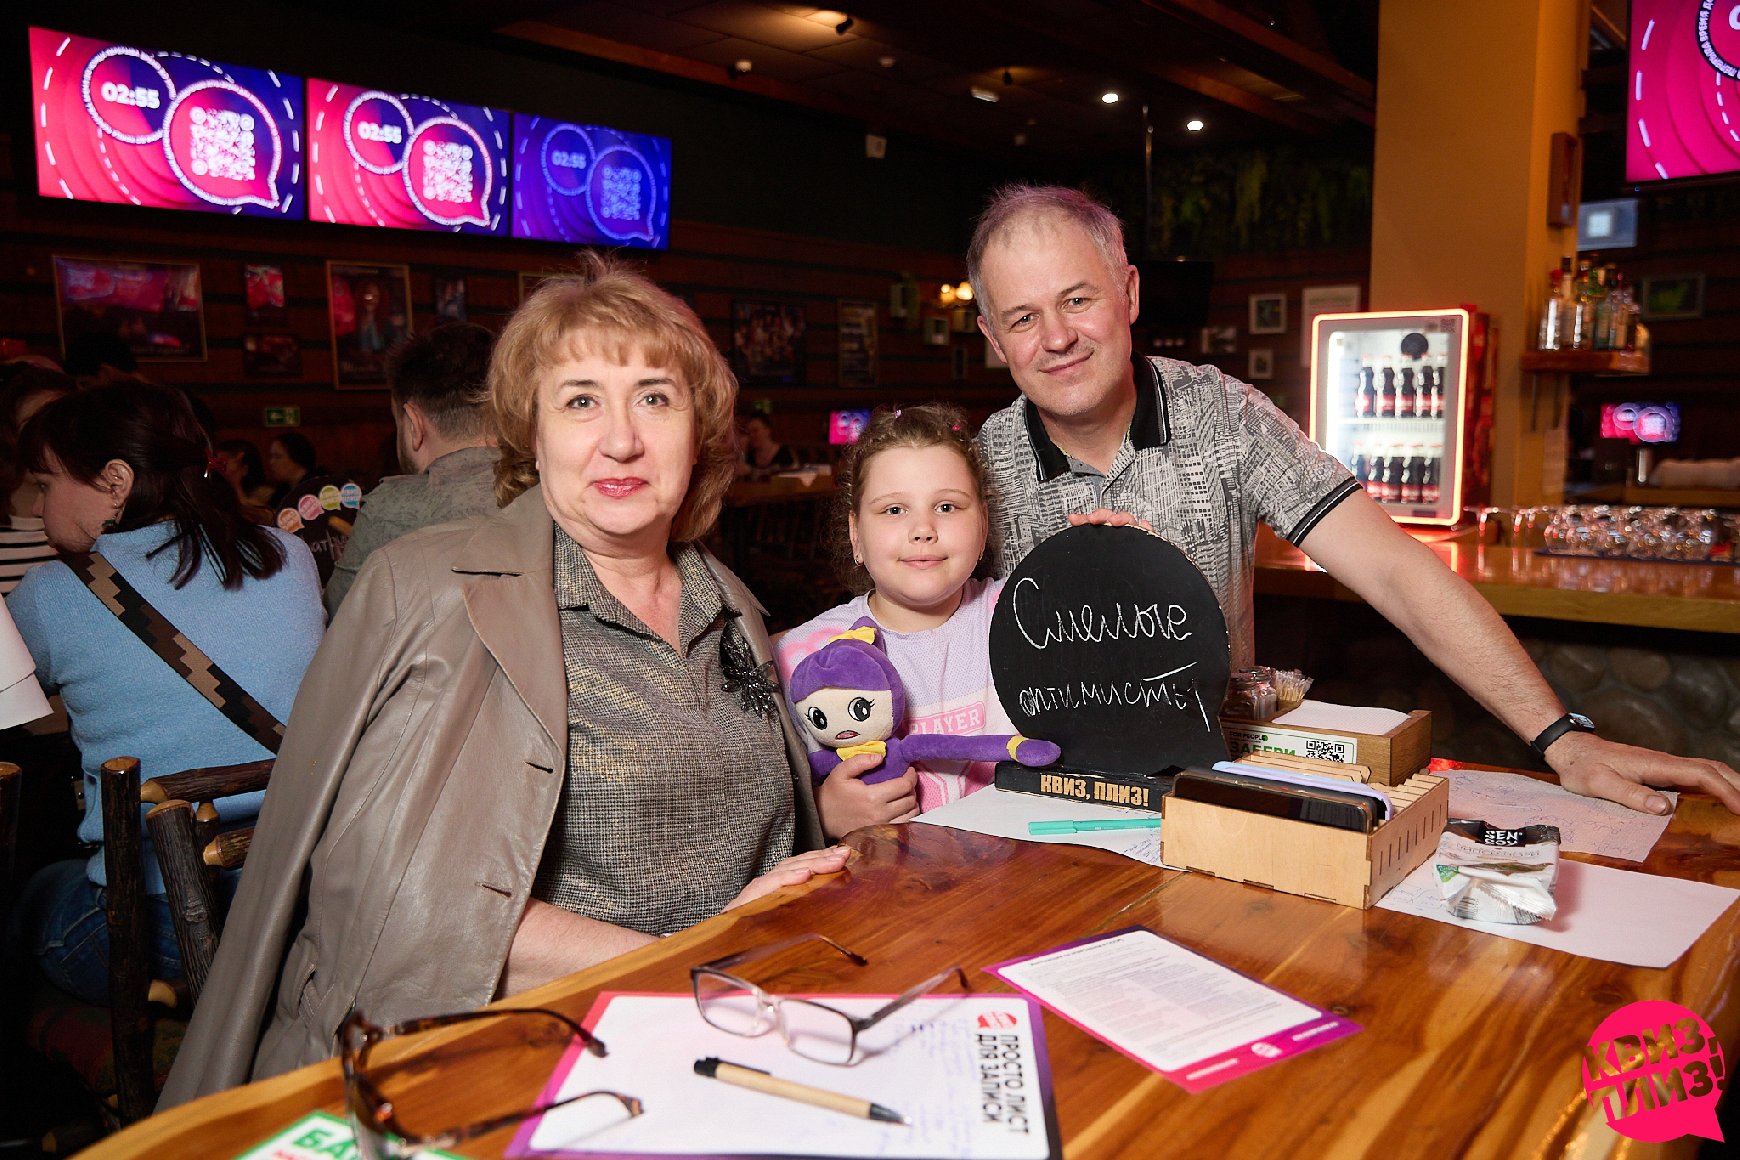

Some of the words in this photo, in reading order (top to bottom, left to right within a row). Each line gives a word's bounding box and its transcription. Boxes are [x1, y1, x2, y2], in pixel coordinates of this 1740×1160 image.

[101, 82, 160, 109] 02:55
[1013, 577, 1193, 650] Смелые
[1040, 774, 1091, 800] КВИЗ,
[1094, 780, 1149, 807] ПЛИЗ!
[976, 1033, 998, 1059] ДЛЯ
[1000, 1034, 1023, 1089] ПРОСТО
[980, 1059, 1003, 1123] ЗАПИСИ
[1005, 1092, 1029, 1133] ЛИСТ
